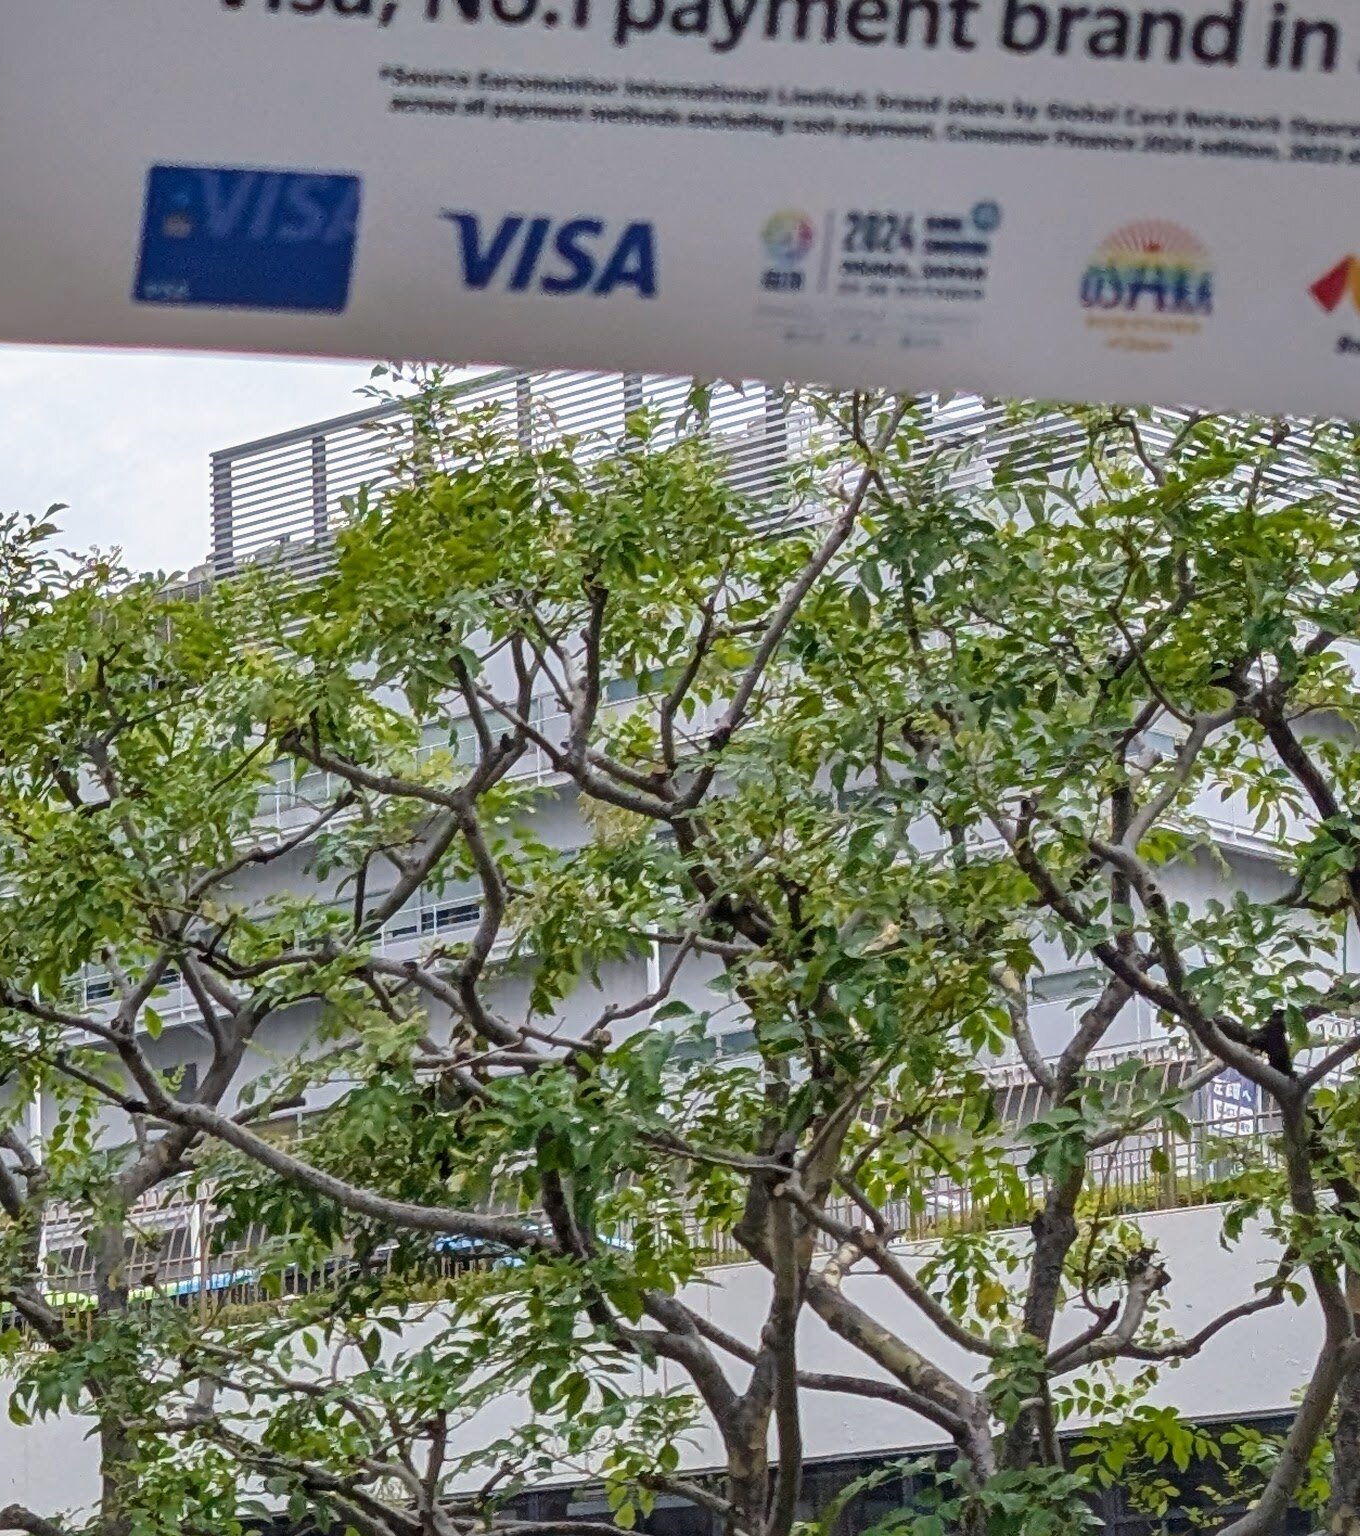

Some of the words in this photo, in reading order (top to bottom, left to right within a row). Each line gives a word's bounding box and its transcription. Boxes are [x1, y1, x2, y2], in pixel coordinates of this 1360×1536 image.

[613, 0, 976, 52] payment
[999, 0, 1244, 67] brand
[1264, 2, 1337, 73] in
[439, 207, 659, 299] VISA
[841, 210, 915, 253] 2024
